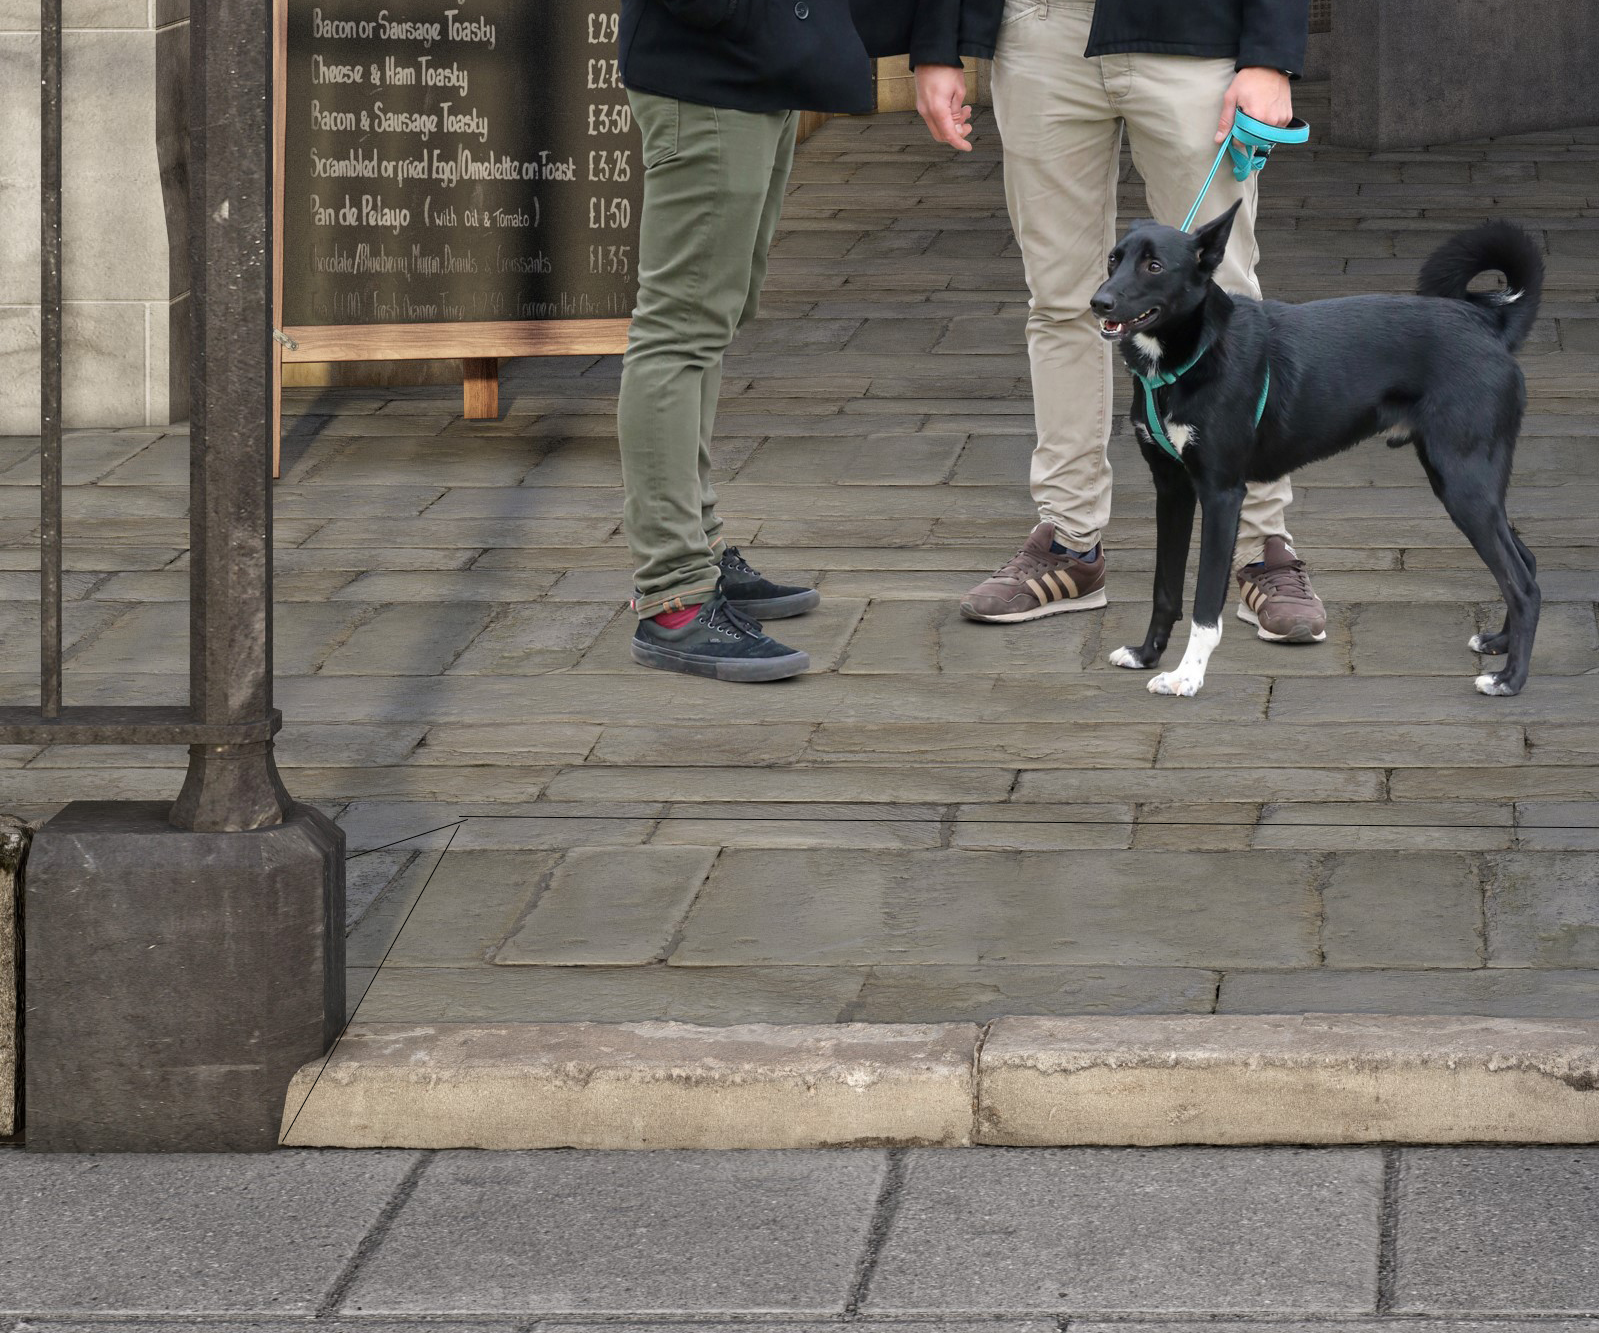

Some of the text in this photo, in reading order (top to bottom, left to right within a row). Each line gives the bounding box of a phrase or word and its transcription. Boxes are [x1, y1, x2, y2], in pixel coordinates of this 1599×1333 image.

[312, 7, 357, 40] Bacon
[357, 19, 377, 39] or
[377, 9, 442, 49] Sausage
[444, 9, 496, 51] Toasty
[311, 54, 364, 85] Cheese
[370, 63, 382, 87] &
[385, 55, 416, 86] Ham
[418, 55, 469, 97] Toasty
[310, 99, 356, 132] Bacon
[359, 110, 371, 131] &
[373, 101, 438, 141] Sausage
[440, 102, 489, 143] Toasty
[309, 147, 379, 179] Scrambled
[380, 159, 397, 179] or
[521, 161, 539, 180] on
[538, 150, 577, 182] Toast
[309, 194, 335, 227] Pan
[338, 194, 359, 227] de
[361, 194, 411, 235] Pelayo
[463, 209, 480, 228] Oil
[483, 211, 491, 228] &
